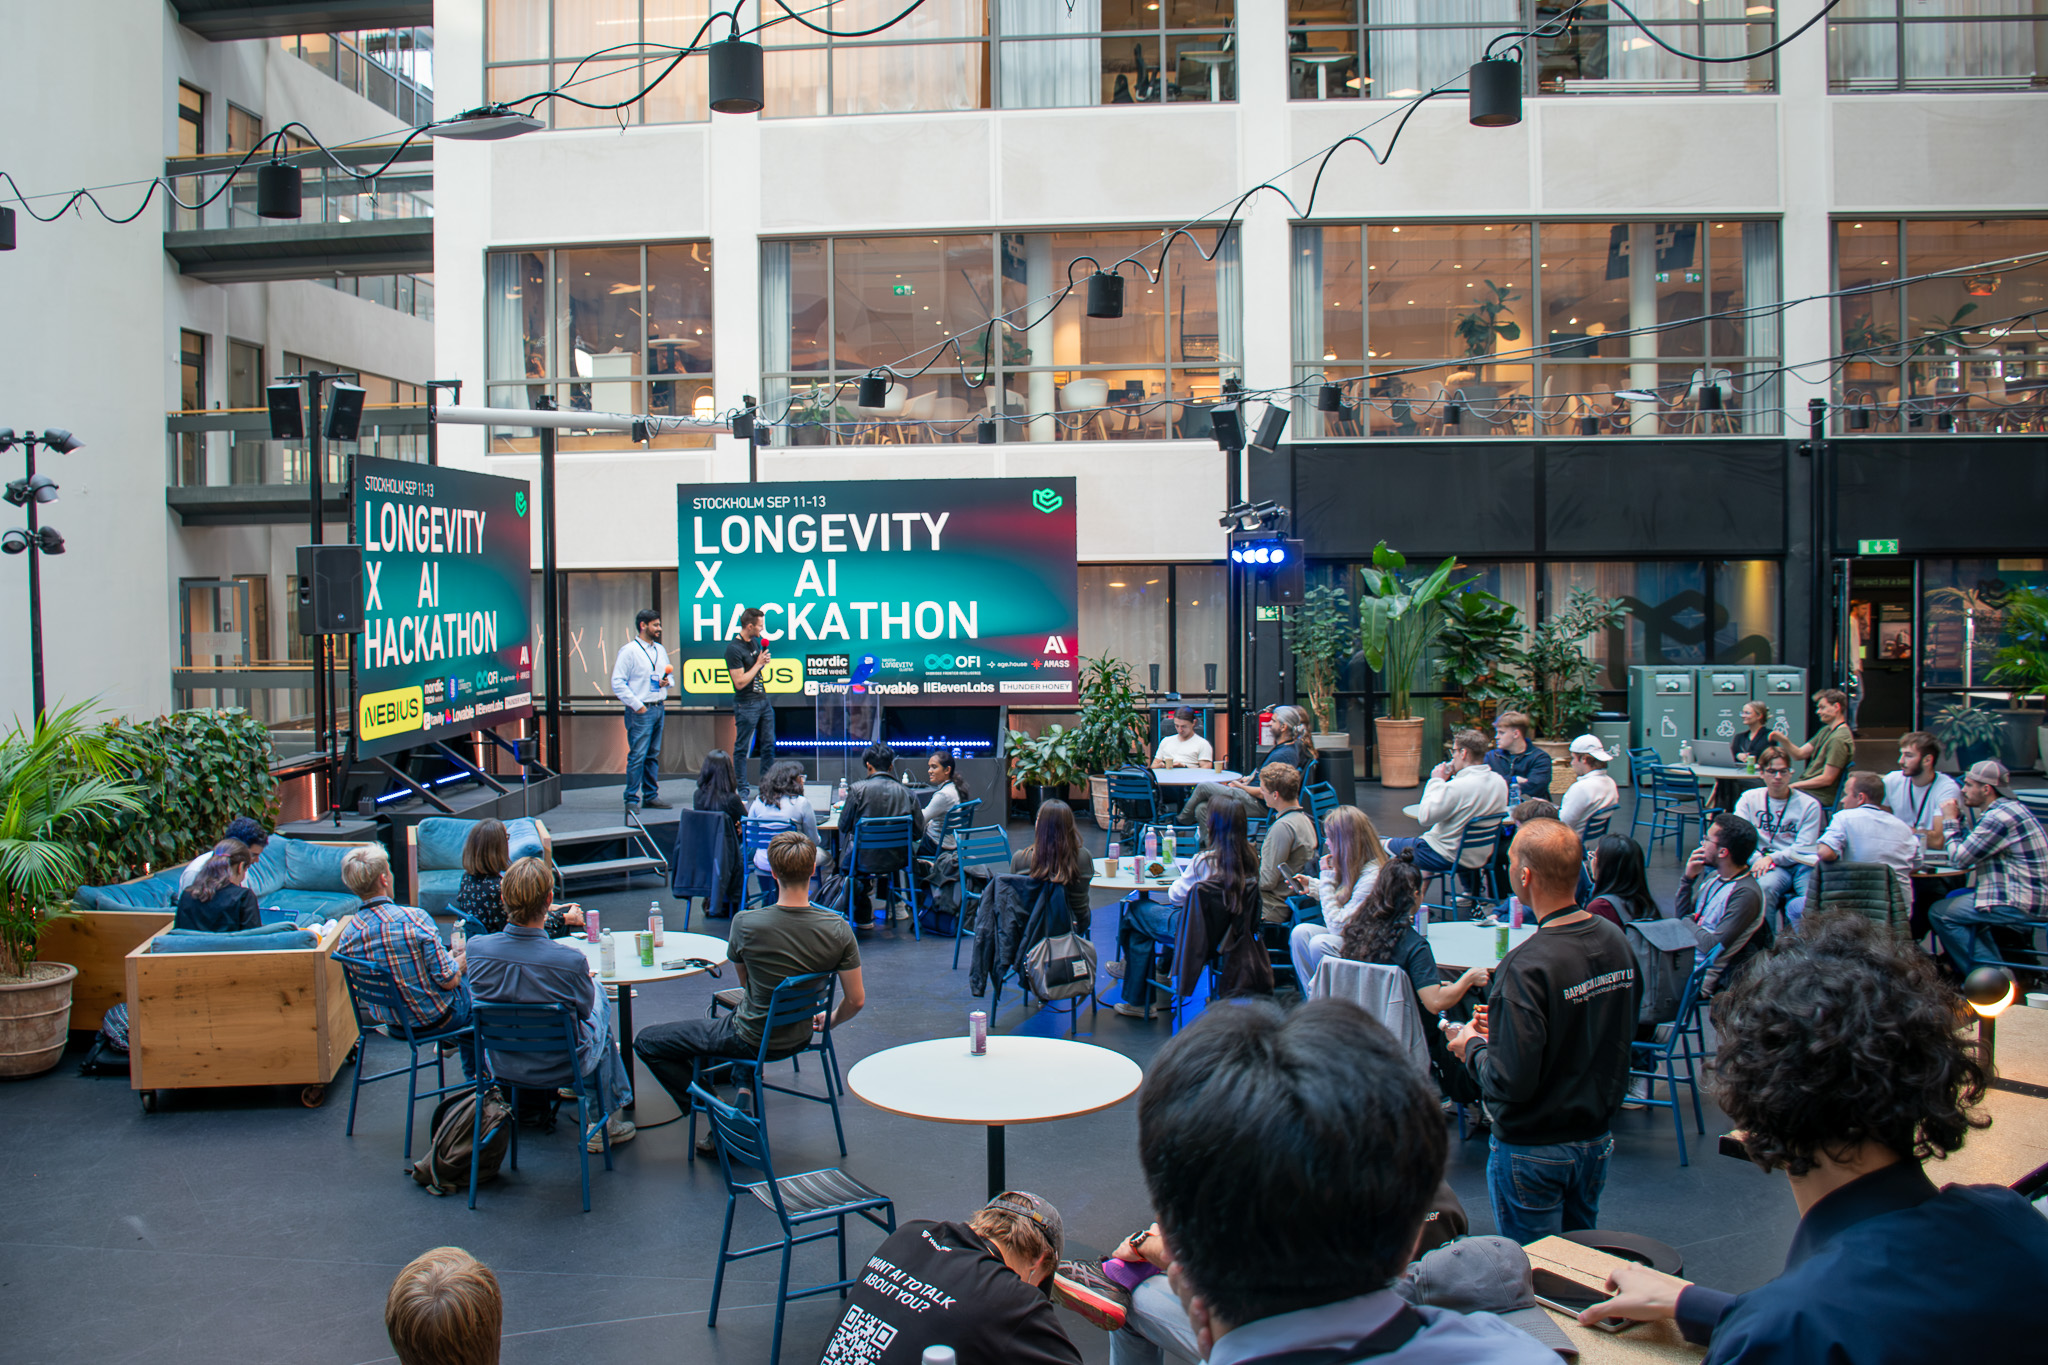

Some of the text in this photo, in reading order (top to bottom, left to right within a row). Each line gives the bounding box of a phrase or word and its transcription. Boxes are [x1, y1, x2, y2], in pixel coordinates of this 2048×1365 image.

[365, 475, 435, 498] STOCKHOLM SEP 11-13
[693, 495, 826, 509] STOCKHOLM SEP 11-13
[366, 501, 485, 554] LONGEVITY
[694, 512, 949, 554] LONGEVITY
[366, 561, 438, 611] X AI
[695, 559, 836, 598] X AI
[693, 601, 977, 641] HACKATHON
[365, 611, 497, 669] HACKATHON
[808, 656, 847, 667] nordic
[955, 656, 981, 668] OFI
[1043, 660, 1070, 668] AMASS
[487, 671, 498, 686] OFI
[693, 668, 794, 684] NEUS
[424, 680, 445, 696] nordic
[868, 681, 919, 695] Lovable
[1003, 683, 1070, 691] THUNDER HONEY
[365, 698, 419, 728] NEBIUS
[452, 705, 475, 723] Lovable
[862, 1272, 931, 1313] ABOUT YOU?
[867, 1256, 957, 1310] WANT AI TO TALK
